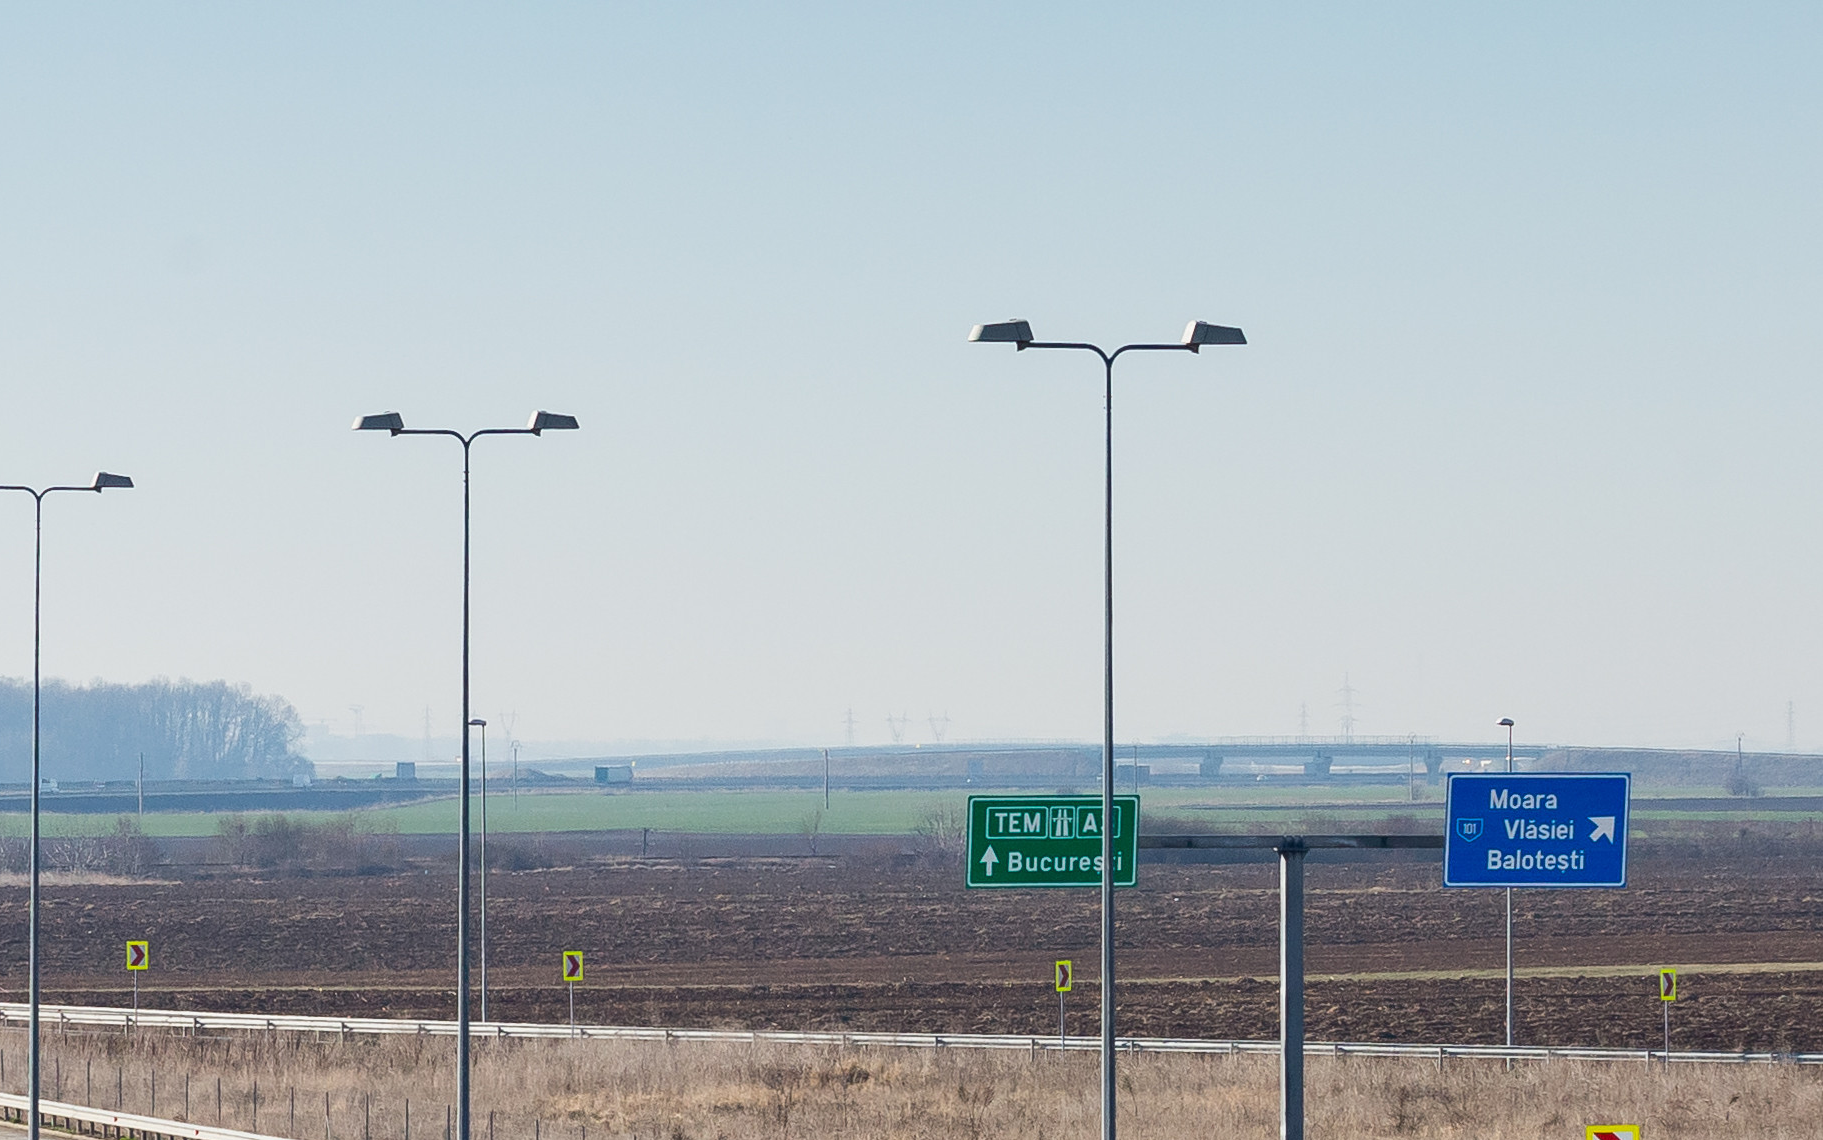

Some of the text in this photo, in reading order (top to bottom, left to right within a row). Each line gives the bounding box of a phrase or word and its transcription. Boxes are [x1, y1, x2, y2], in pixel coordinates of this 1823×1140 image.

[1489, 788, 1558, 810] Moara
[995, 812, 1041, 833] TEM
[1463, 818, 1574, 840] 101 Vlăsiei
[1008, 851, 1123, 875] Bucureși
[1487, 849, 1585, 874] Balotești
